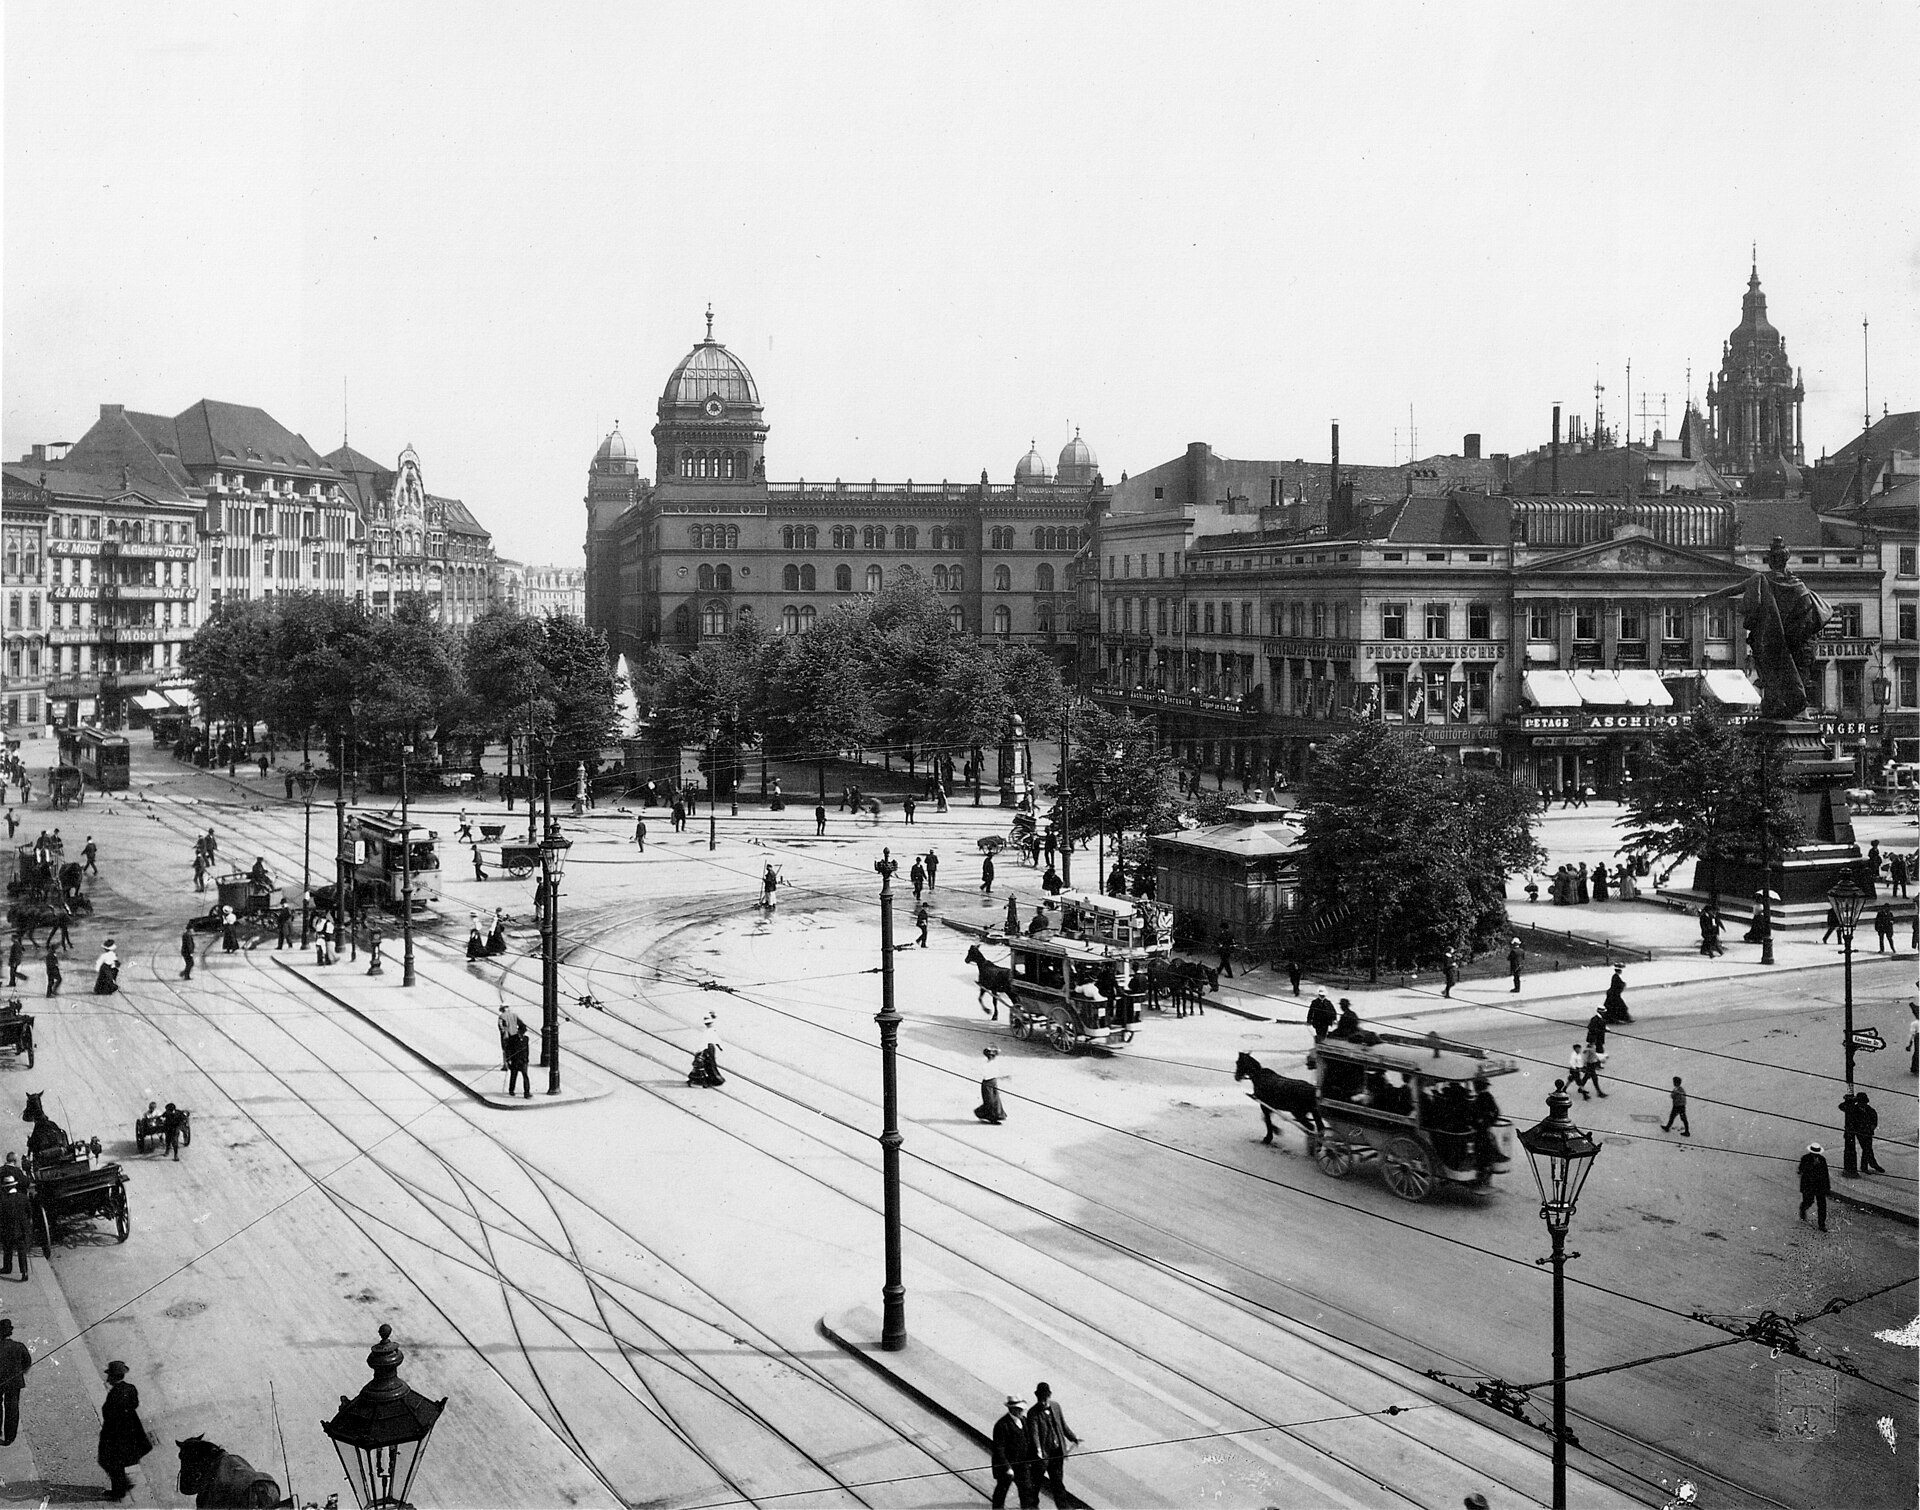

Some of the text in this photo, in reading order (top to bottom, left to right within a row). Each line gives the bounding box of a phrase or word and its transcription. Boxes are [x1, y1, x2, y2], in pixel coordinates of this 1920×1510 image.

[56, 543, 100, 555] 42 Möbel
[164, 546, 197, 558] bel 42
[55, 587, 98, 599] 42 Möbel
[163, 587, 184, 599] öbel
[185, 588, 196, 599] 42
[120, 630, 158, 641] Möbel
[1366, 646, 1505, 659] PHOTOGRAPHISCHES
[1818, 644, 1873, 656] EROLINA
[1534, 718, 1569, 728] ETAGE
[1590, 716, 1691, 727] ASCHINGE
